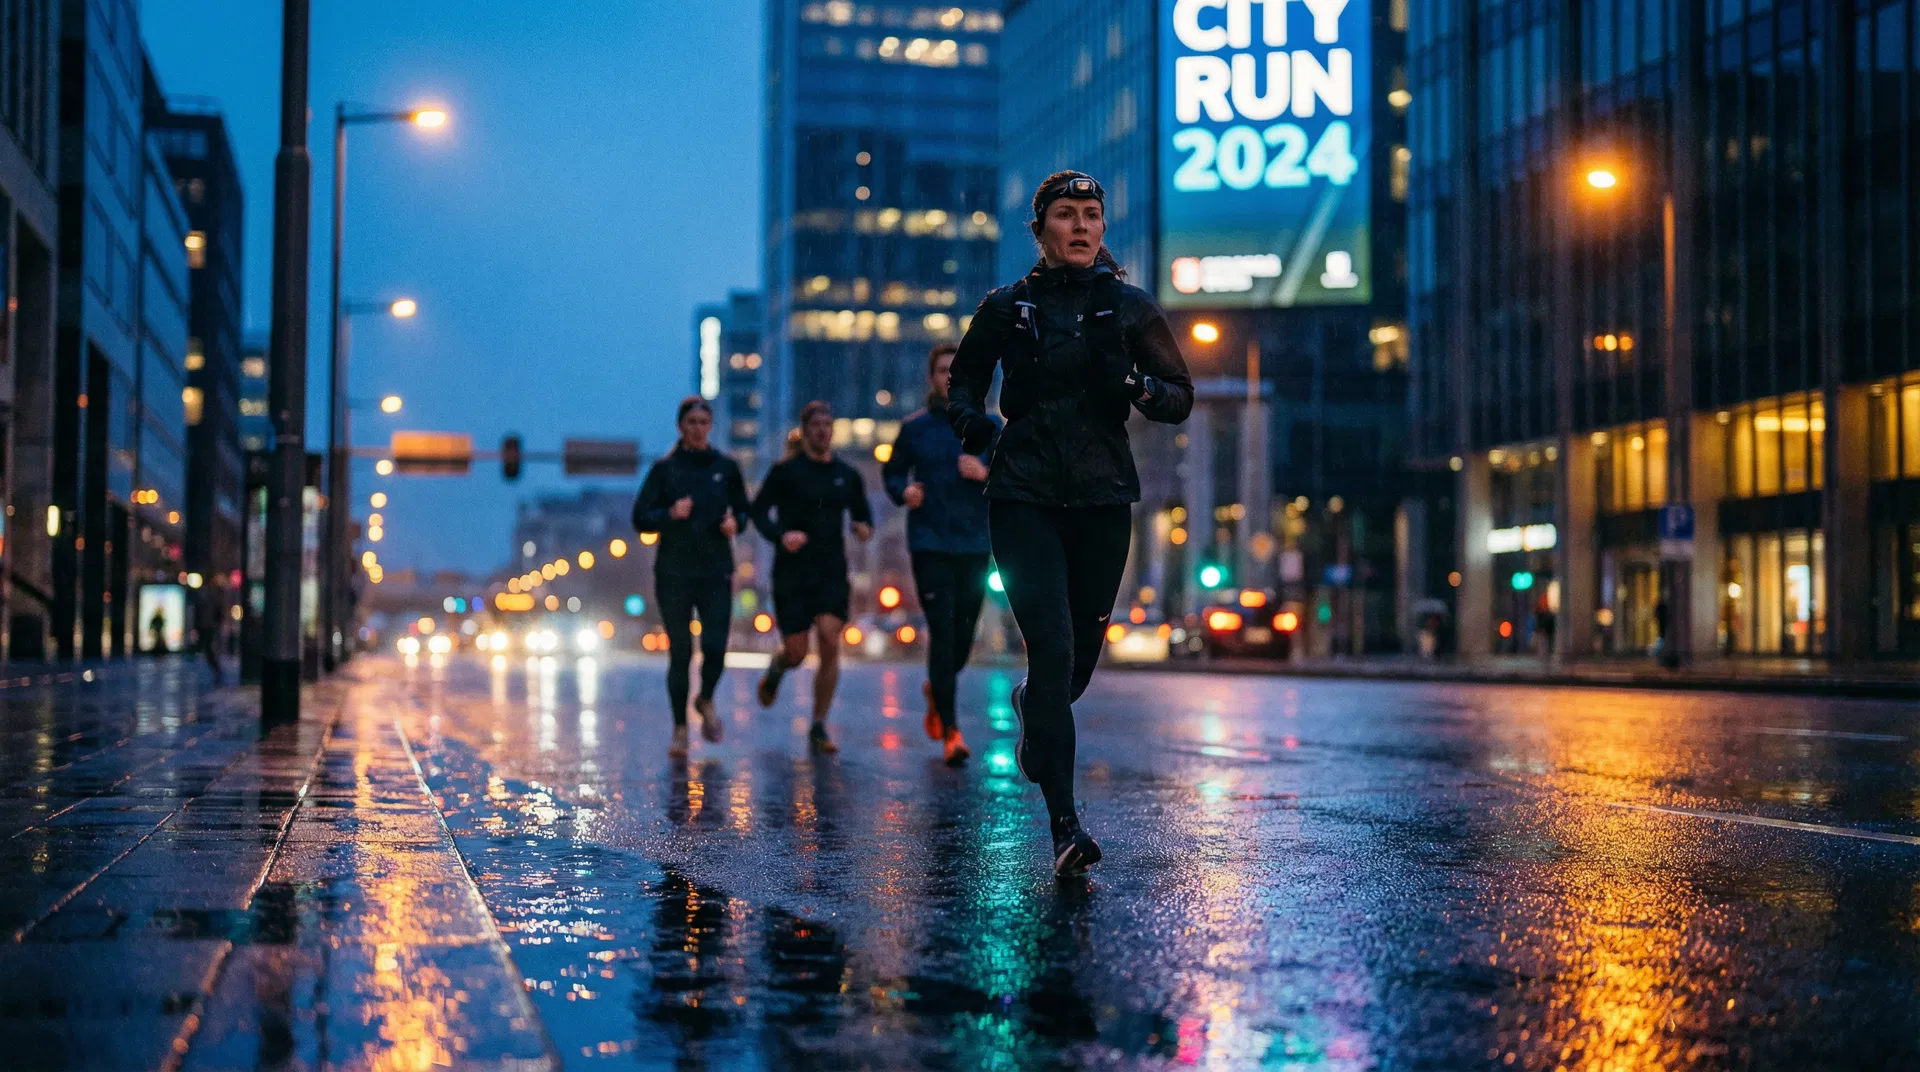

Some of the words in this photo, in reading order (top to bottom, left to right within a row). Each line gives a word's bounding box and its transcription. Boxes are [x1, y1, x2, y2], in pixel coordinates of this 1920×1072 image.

[1173, 0, 1351, 52] CITY
[1175, 48, 1353, 123] RUN
[1172, 120, 1358, 192] 2024
